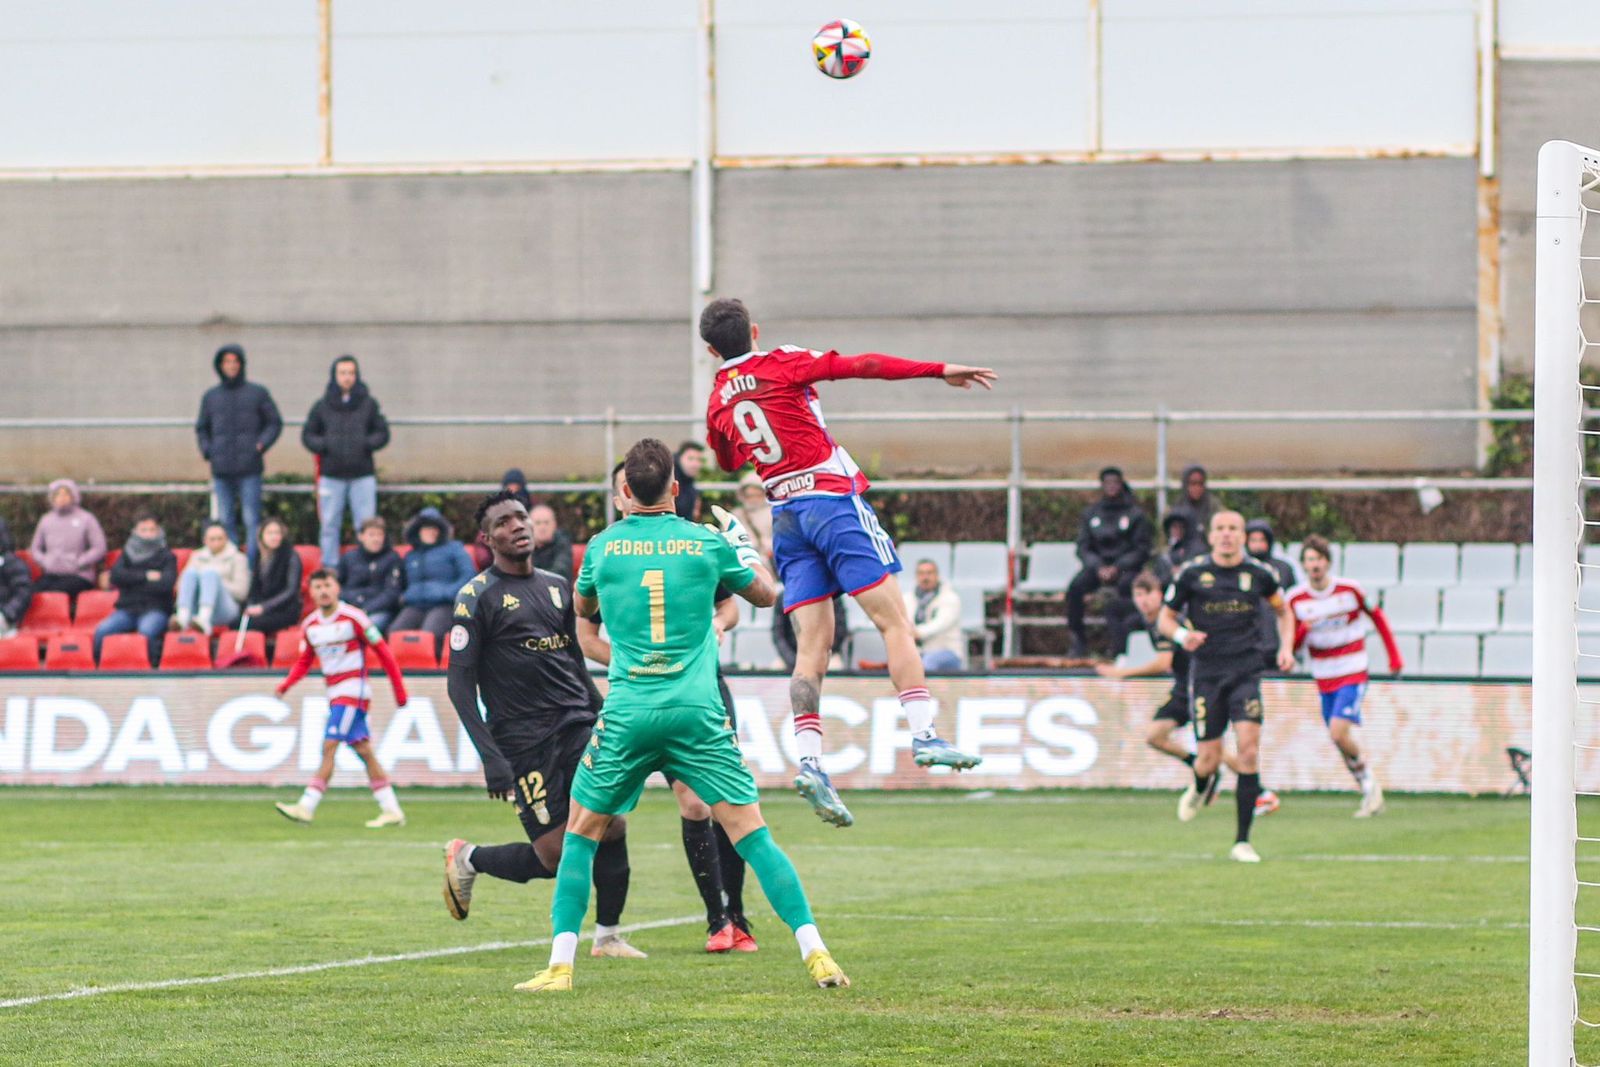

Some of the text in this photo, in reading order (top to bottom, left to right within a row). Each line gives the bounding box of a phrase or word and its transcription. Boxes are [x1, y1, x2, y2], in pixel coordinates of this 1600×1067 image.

[733, 400, 784, 466] 9
[604, 534, 704, 557] PEDRO LÓPEZ
[640, 569, 667, 644] 1
[518, 770, 547, 805] 12
